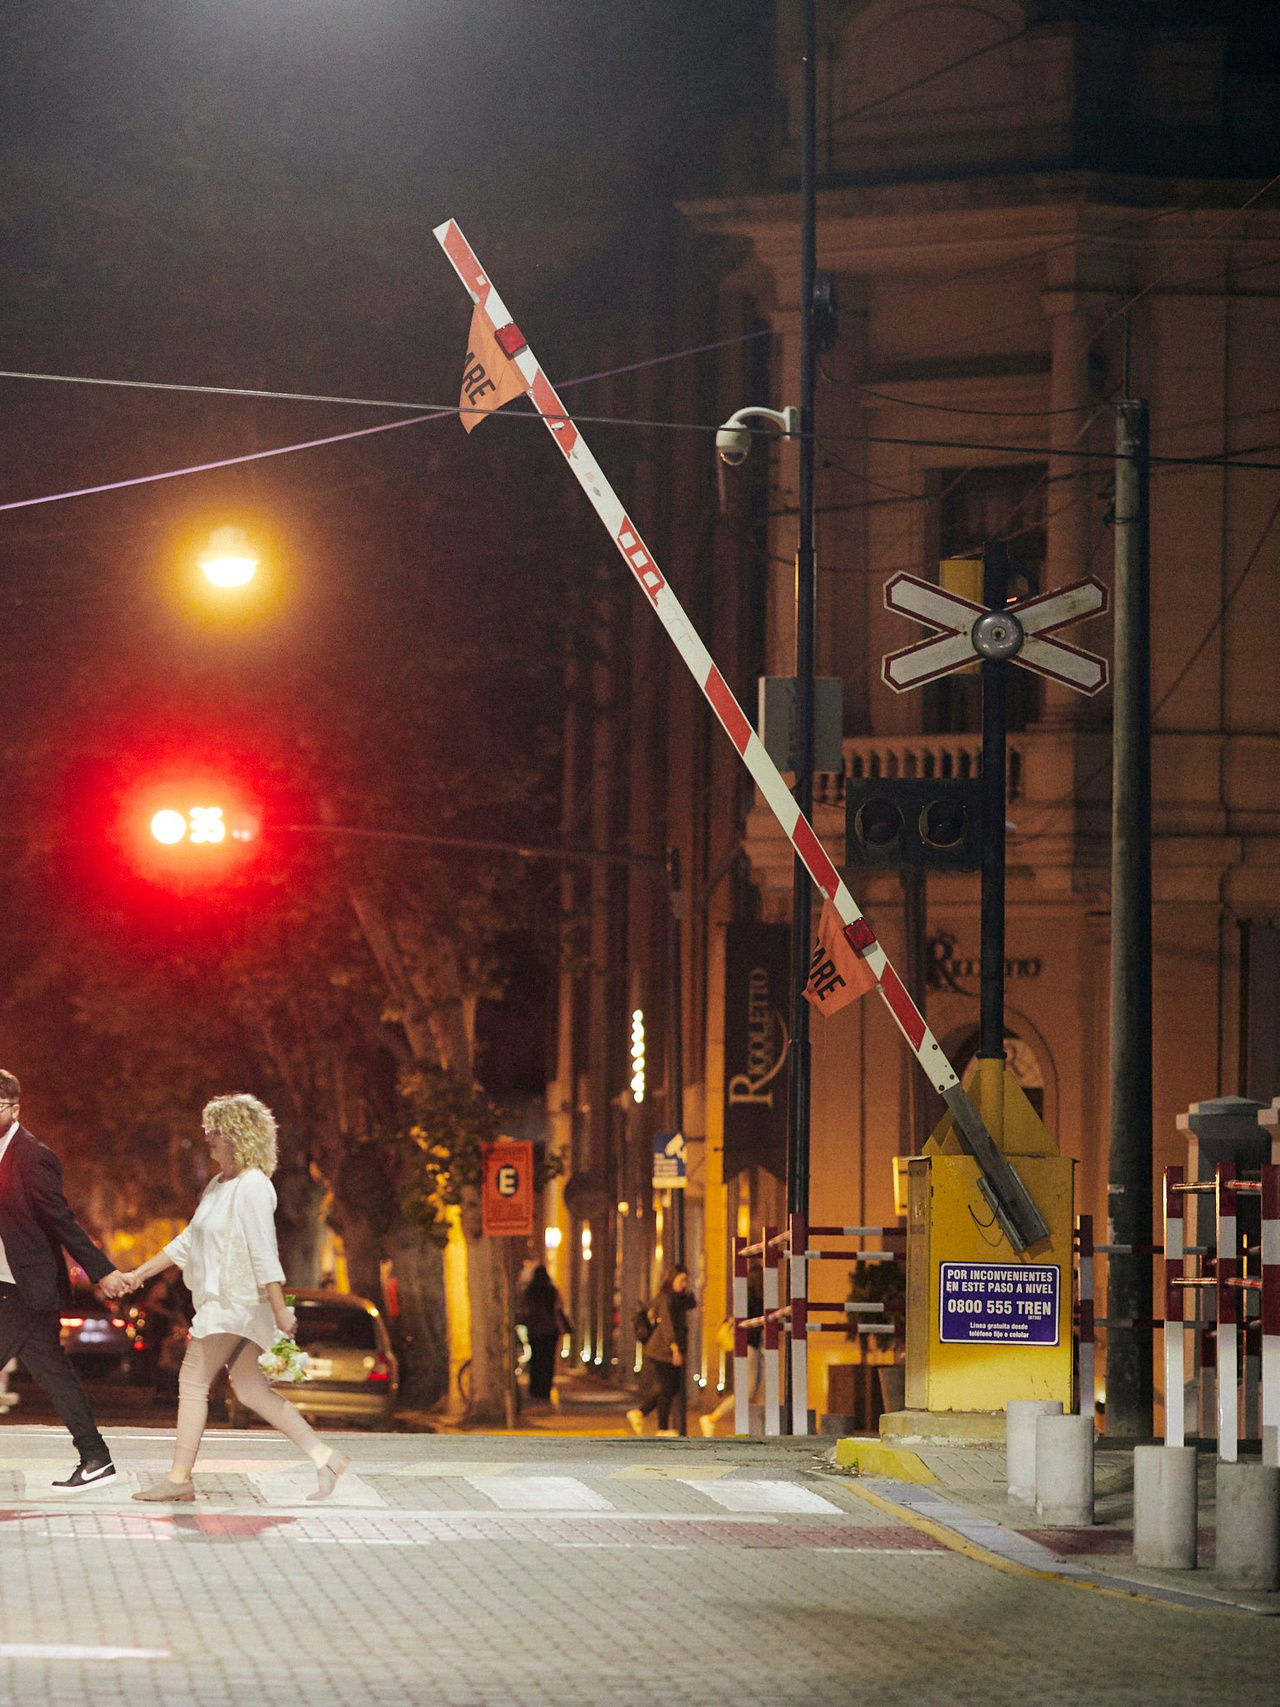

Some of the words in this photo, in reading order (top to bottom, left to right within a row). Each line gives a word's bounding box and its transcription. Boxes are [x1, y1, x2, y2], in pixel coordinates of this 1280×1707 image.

[499, 1168, 516, 1194] E
[947, 1269, 967, 1280] POR
[970, 1270, 1053, 1282] INCONVENIENTES
[946, 1281, 959, 1292] EN
[962, 1282, 985, 1292] ESTE
[988, 1283, 1014, 1293] PASO
[1016, 1284, 1023, 1293] A
[1025, 1284, 1053, 1294] NIVEL
[947, 1299, 982, 1314] 0800
[986, 1300, 1012, 1314] 555
[1016, 1301, 1051, 1315] TREN
